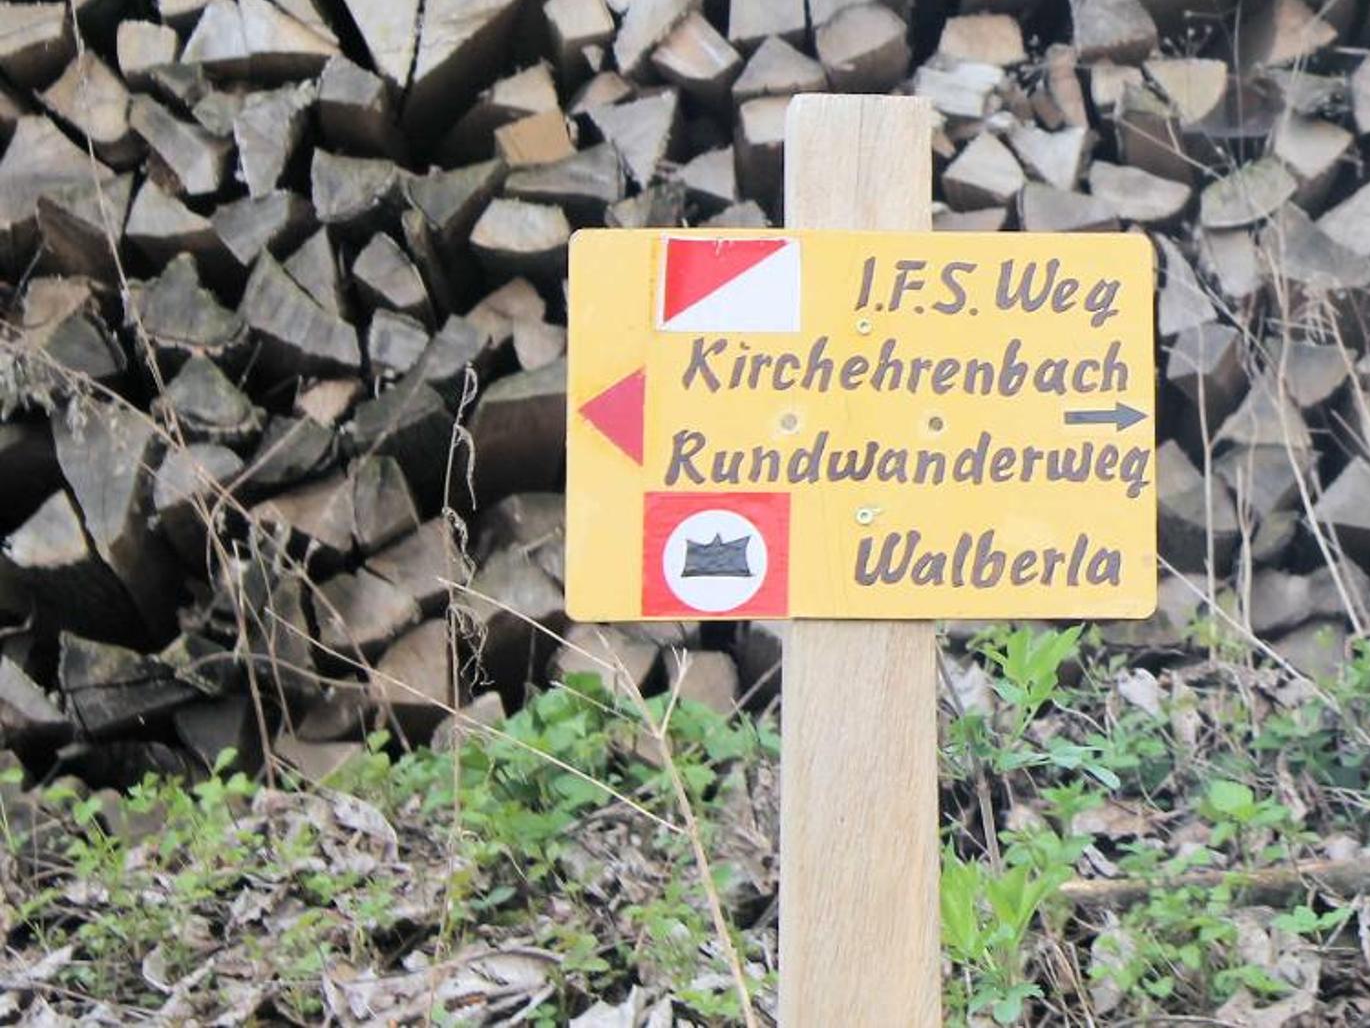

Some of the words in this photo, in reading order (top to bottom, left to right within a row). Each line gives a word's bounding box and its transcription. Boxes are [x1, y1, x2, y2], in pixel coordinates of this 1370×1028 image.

[996, 258, 1122, 327] Weg
[681, 336, 1129, 397] Kirchehrenbach
[663, 429, 1151, 499] Rundwanderweg
[854, 528, 1122, 589] Walberla
